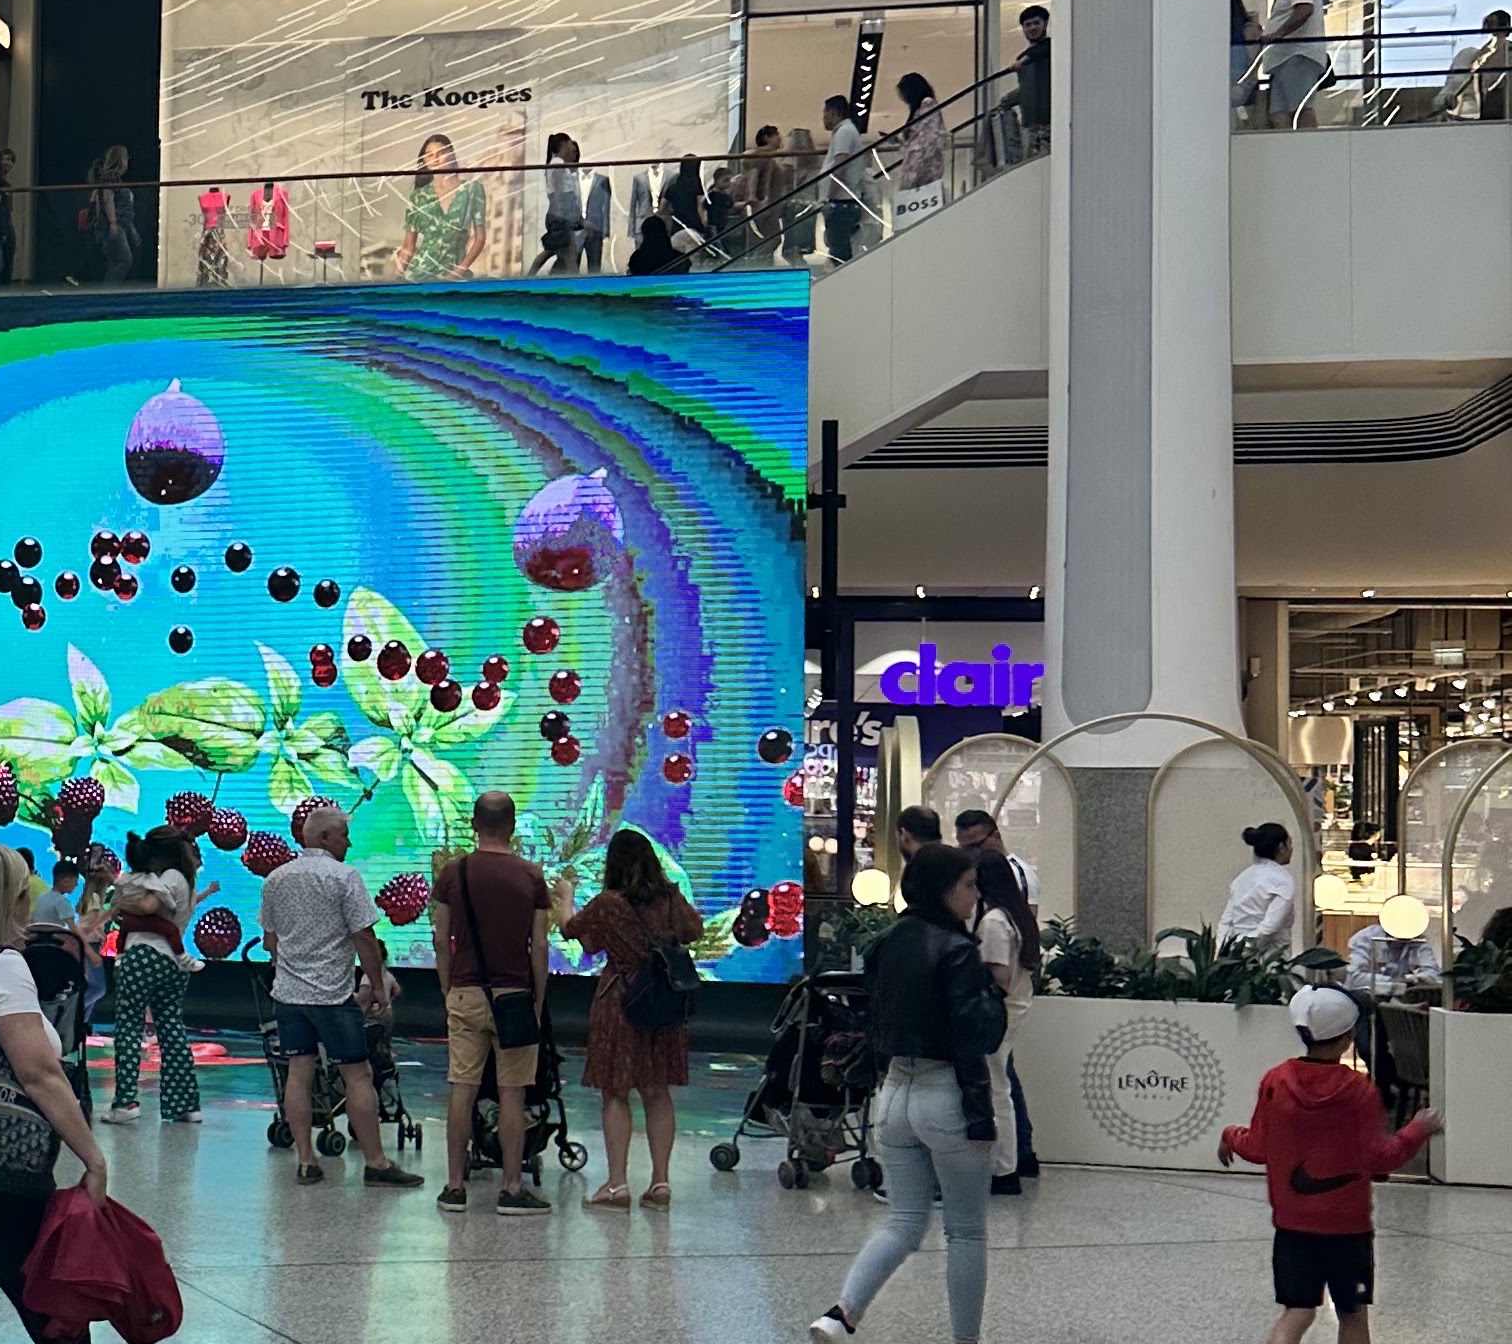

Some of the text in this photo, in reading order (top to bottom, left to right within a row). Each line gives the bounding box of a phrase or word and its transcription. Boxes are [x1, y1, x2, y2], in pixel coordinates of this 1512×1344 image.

[361, 84, 532, 110] The Kooples
[896, 195, 938, 216] BOSS
[1117, 1069, 1189, 1093] LENÔTRE
